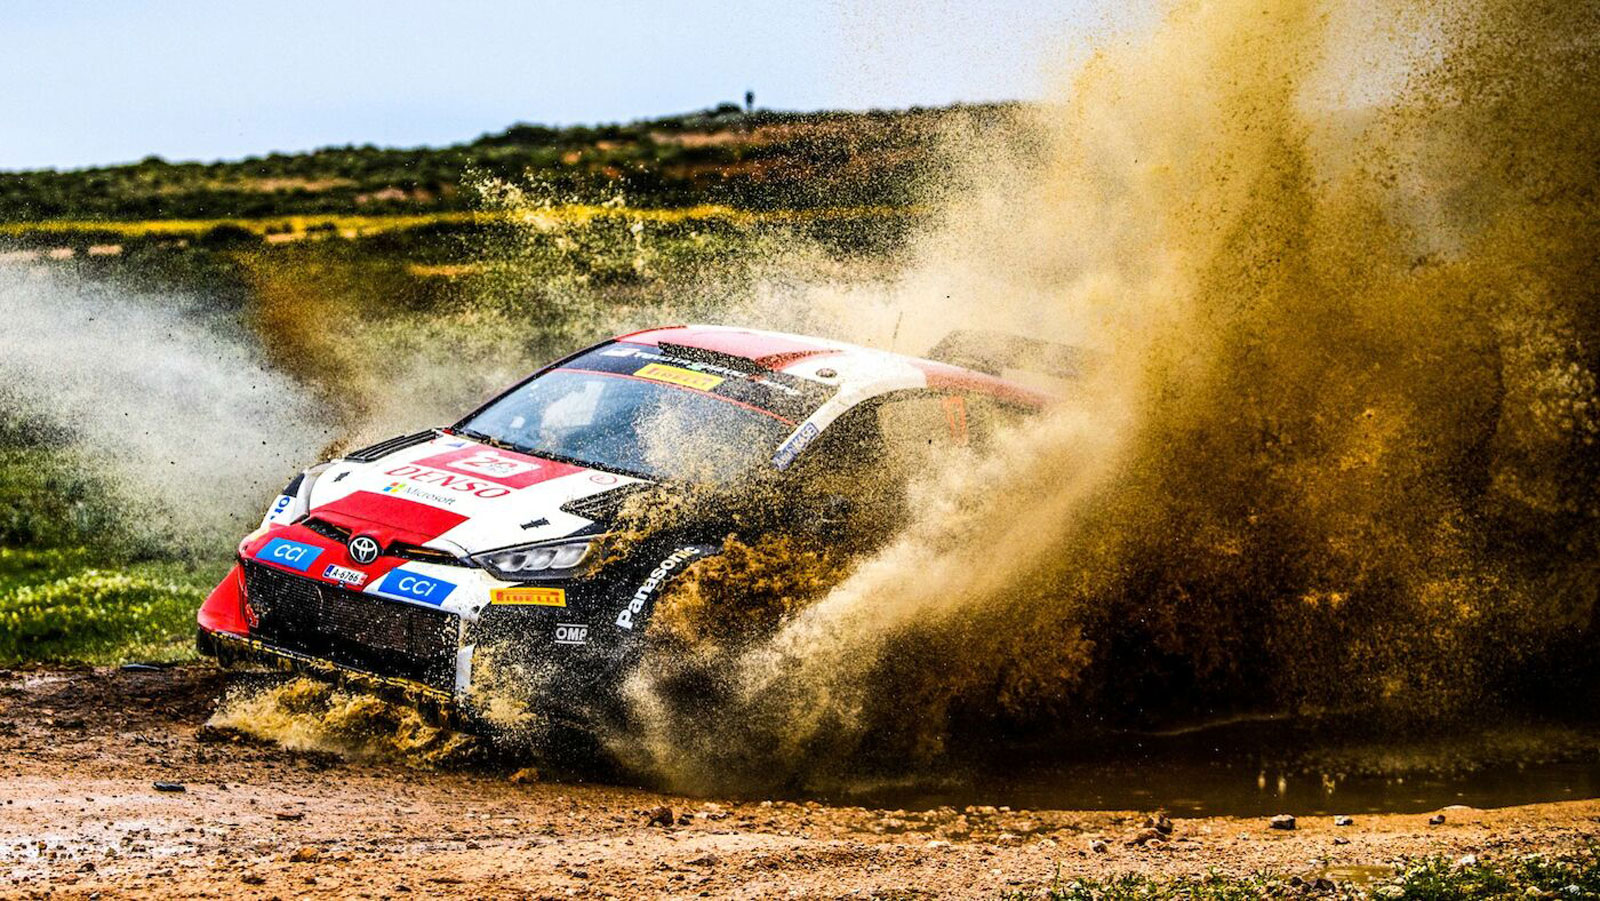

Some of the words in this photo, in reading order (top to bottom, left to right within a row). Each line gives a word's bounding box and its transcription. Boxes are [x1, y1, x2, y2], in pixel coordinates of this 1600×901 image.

[384, 466, 511, 498] DENSO
[404, 486, 456, 506] Microsoft
[496, 590, 560, 604] PIRELLI
[615, 546, 700, 629] Panasonic
[556, 626, 588, 641] OMP
